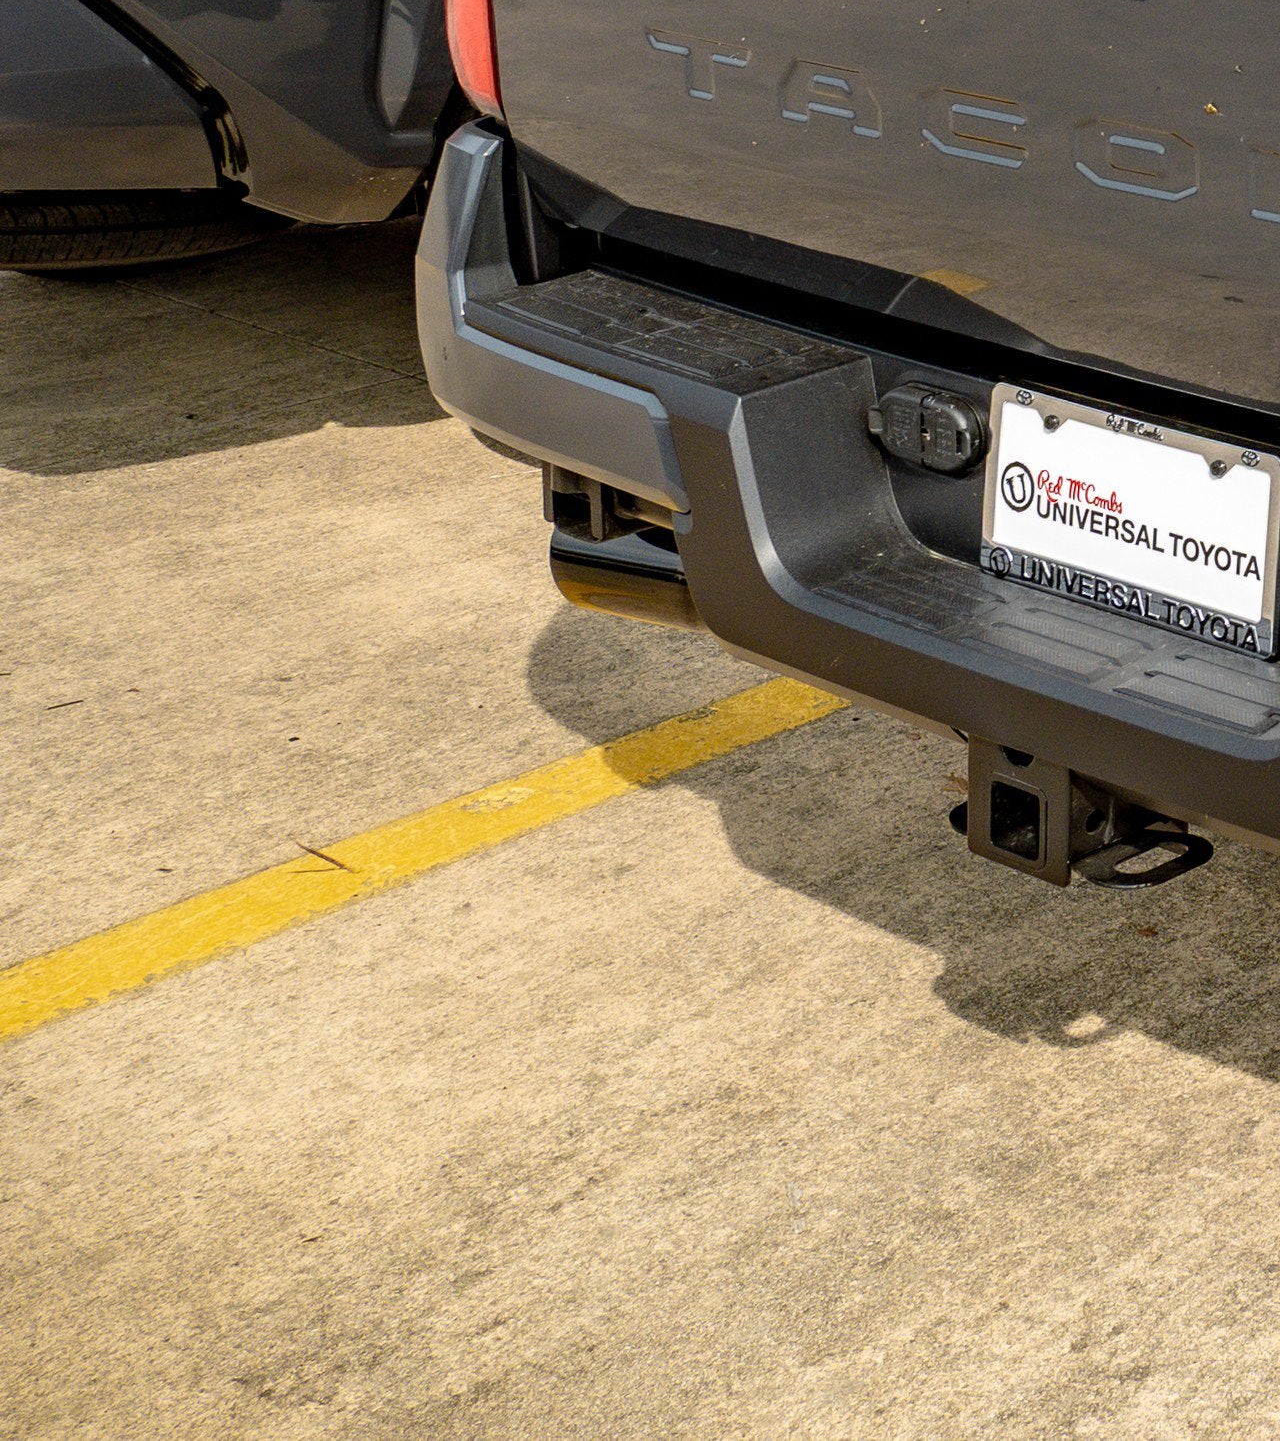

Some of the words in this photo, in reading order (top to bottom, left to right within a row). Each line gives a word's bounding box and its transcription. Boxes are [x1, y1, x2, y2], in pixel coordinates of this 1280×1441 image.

[1037, 469, 1062, 504] Red
[1067, 478, 1123, 514] McCombs
[1036, 495, 1165, 553] UNIVERSAL
[1168, 532, 1262, 581] TOYOTA
[1020, 555, 1160, 621] UNIVERSAL
[1162, 599, 1262, 653] TOYOTA
